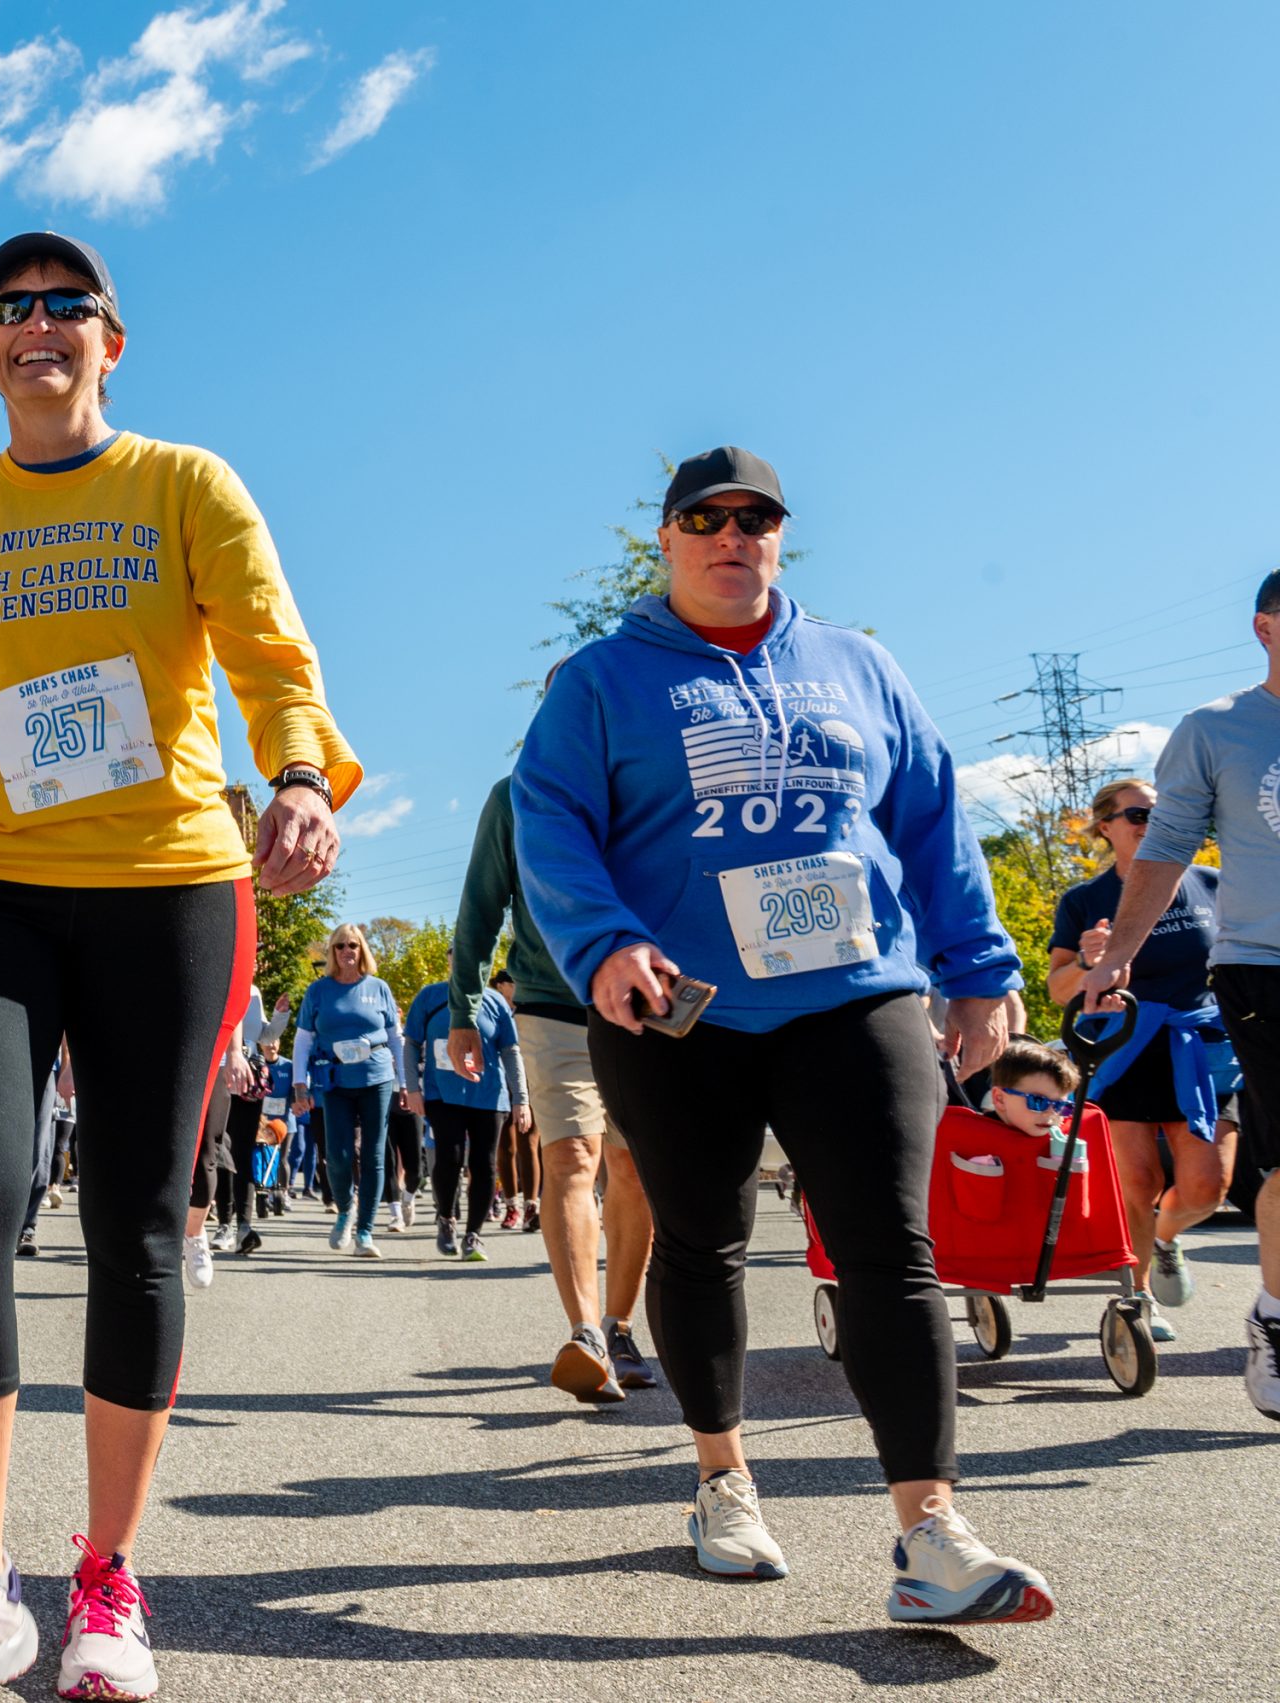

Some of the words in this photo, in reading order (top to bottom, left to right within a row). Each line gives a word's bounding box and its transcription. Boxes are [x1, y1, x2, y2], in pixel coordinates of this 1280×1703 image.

[132, 524, 160, 552] OF
[20, 556, 160, 589] CAROLINA
[19, 676, 58, 698] SHEA'S
[61, 664, 99, 685] CHASE
[39, 692, 60, 707] Run
[71, 682, 97, 697] Walk
[690, 708, 714, 724] 5k
[718, 701, 762, 719] Run
[788, 699, 841, 716] Walk
[25, 695, 105, 768] 257
[696, 783, 762, 797] BENEFITTING
[764, 779, 803, 791] KELIN
[805, 779, 863, 795] FOUNDATIO
[754, 863, 792, 879] SHEA'S
[796, 856, 829, 871] CHASE
[760, 883, 841, 940] 293
[1194, 905, 1213, 917] day
[1151, 921, 1181, 935] cold
[1182, 920, 1211, 930] beer
